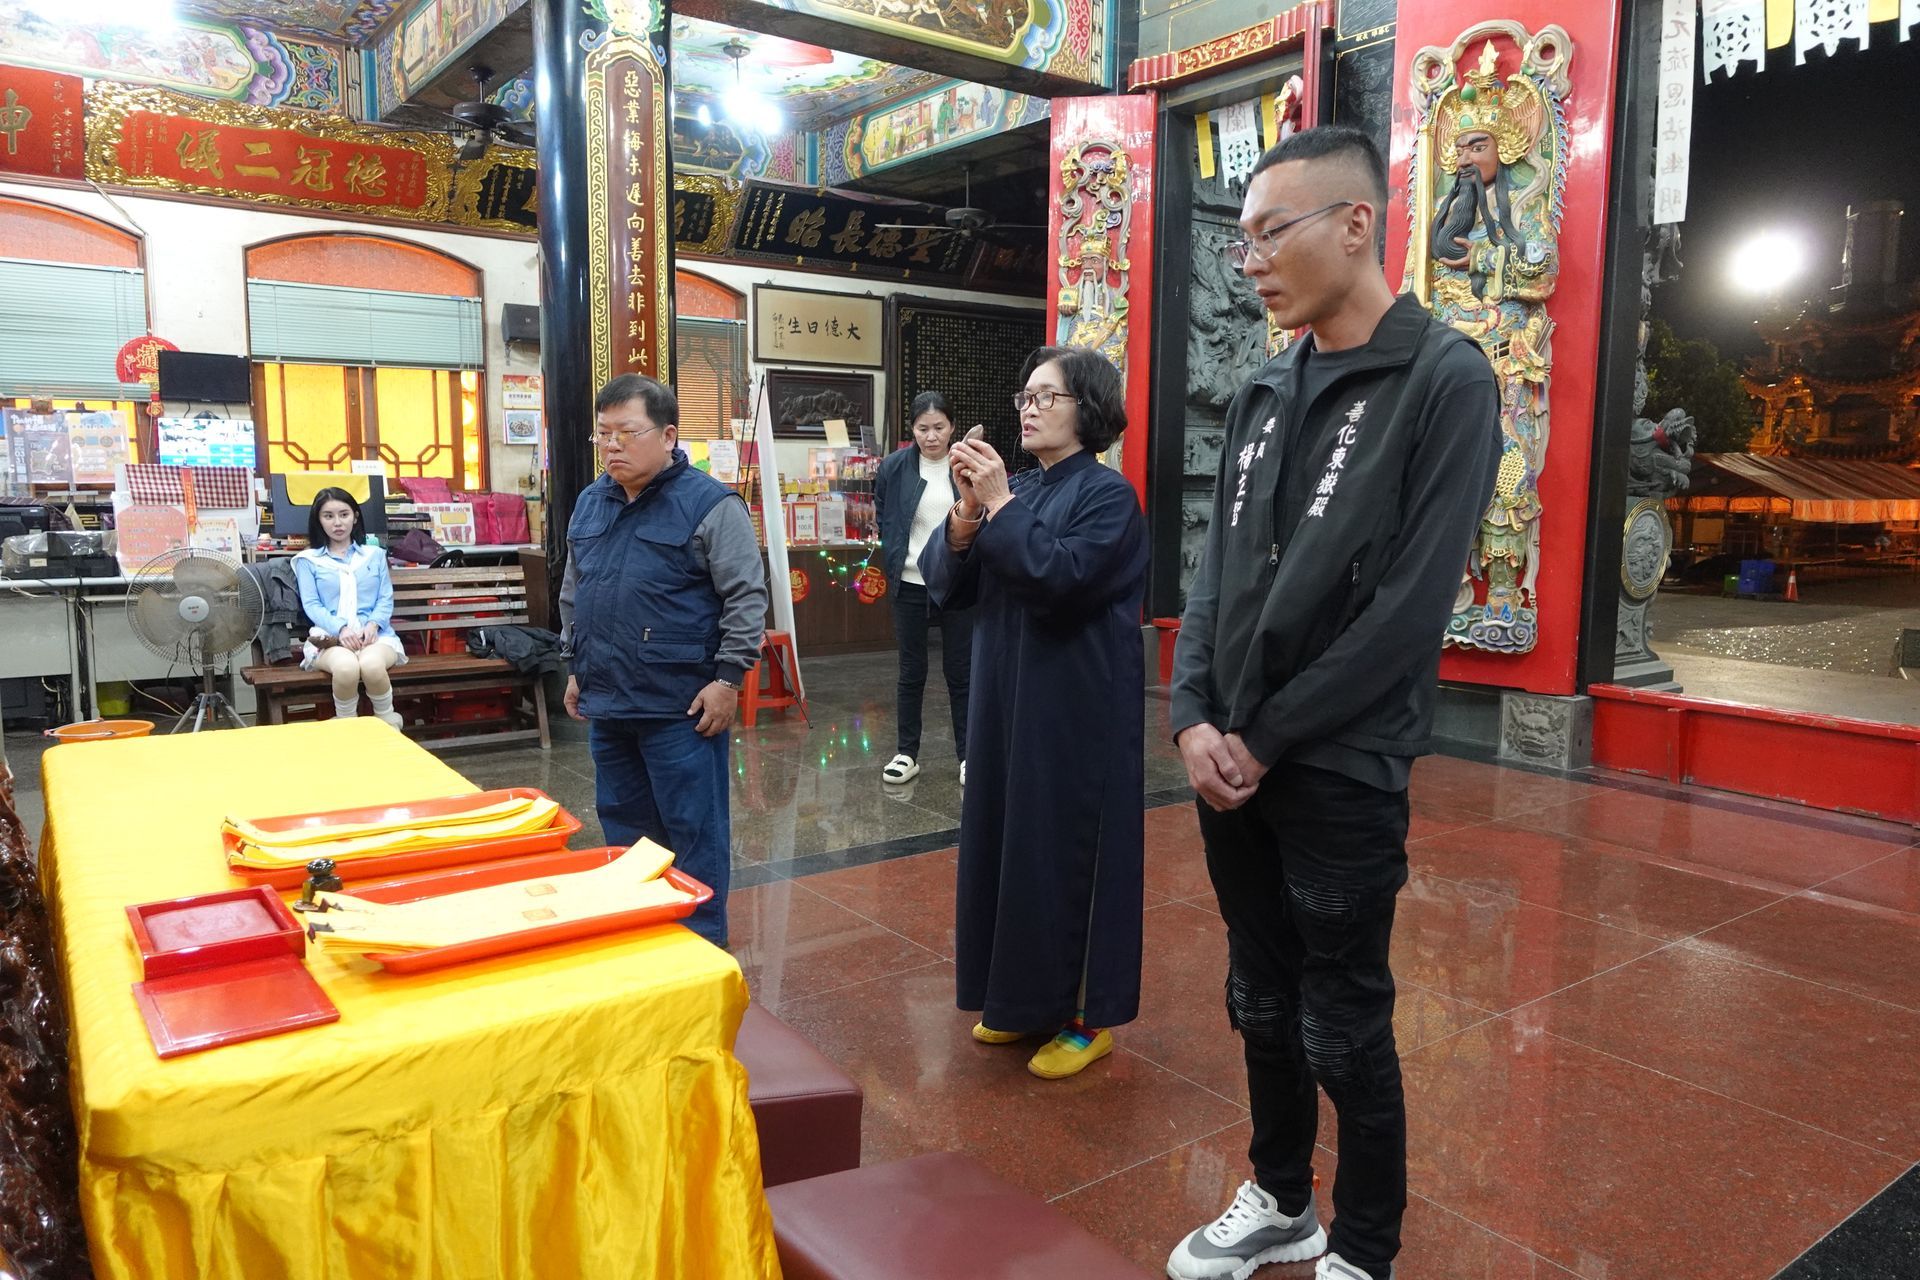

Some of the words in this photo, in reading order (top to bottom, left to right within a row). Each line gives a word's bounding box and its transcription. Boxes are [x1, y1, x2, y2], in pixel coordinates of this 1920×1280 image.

[622, 70, 649, 376] 惡業悔未遲向善去非到此
[787, 315, 862, 341] 大德日生
[1254, 416, 1277, 460] 委員
[1307, 400, 1367, 518] 善化東嶽殿
